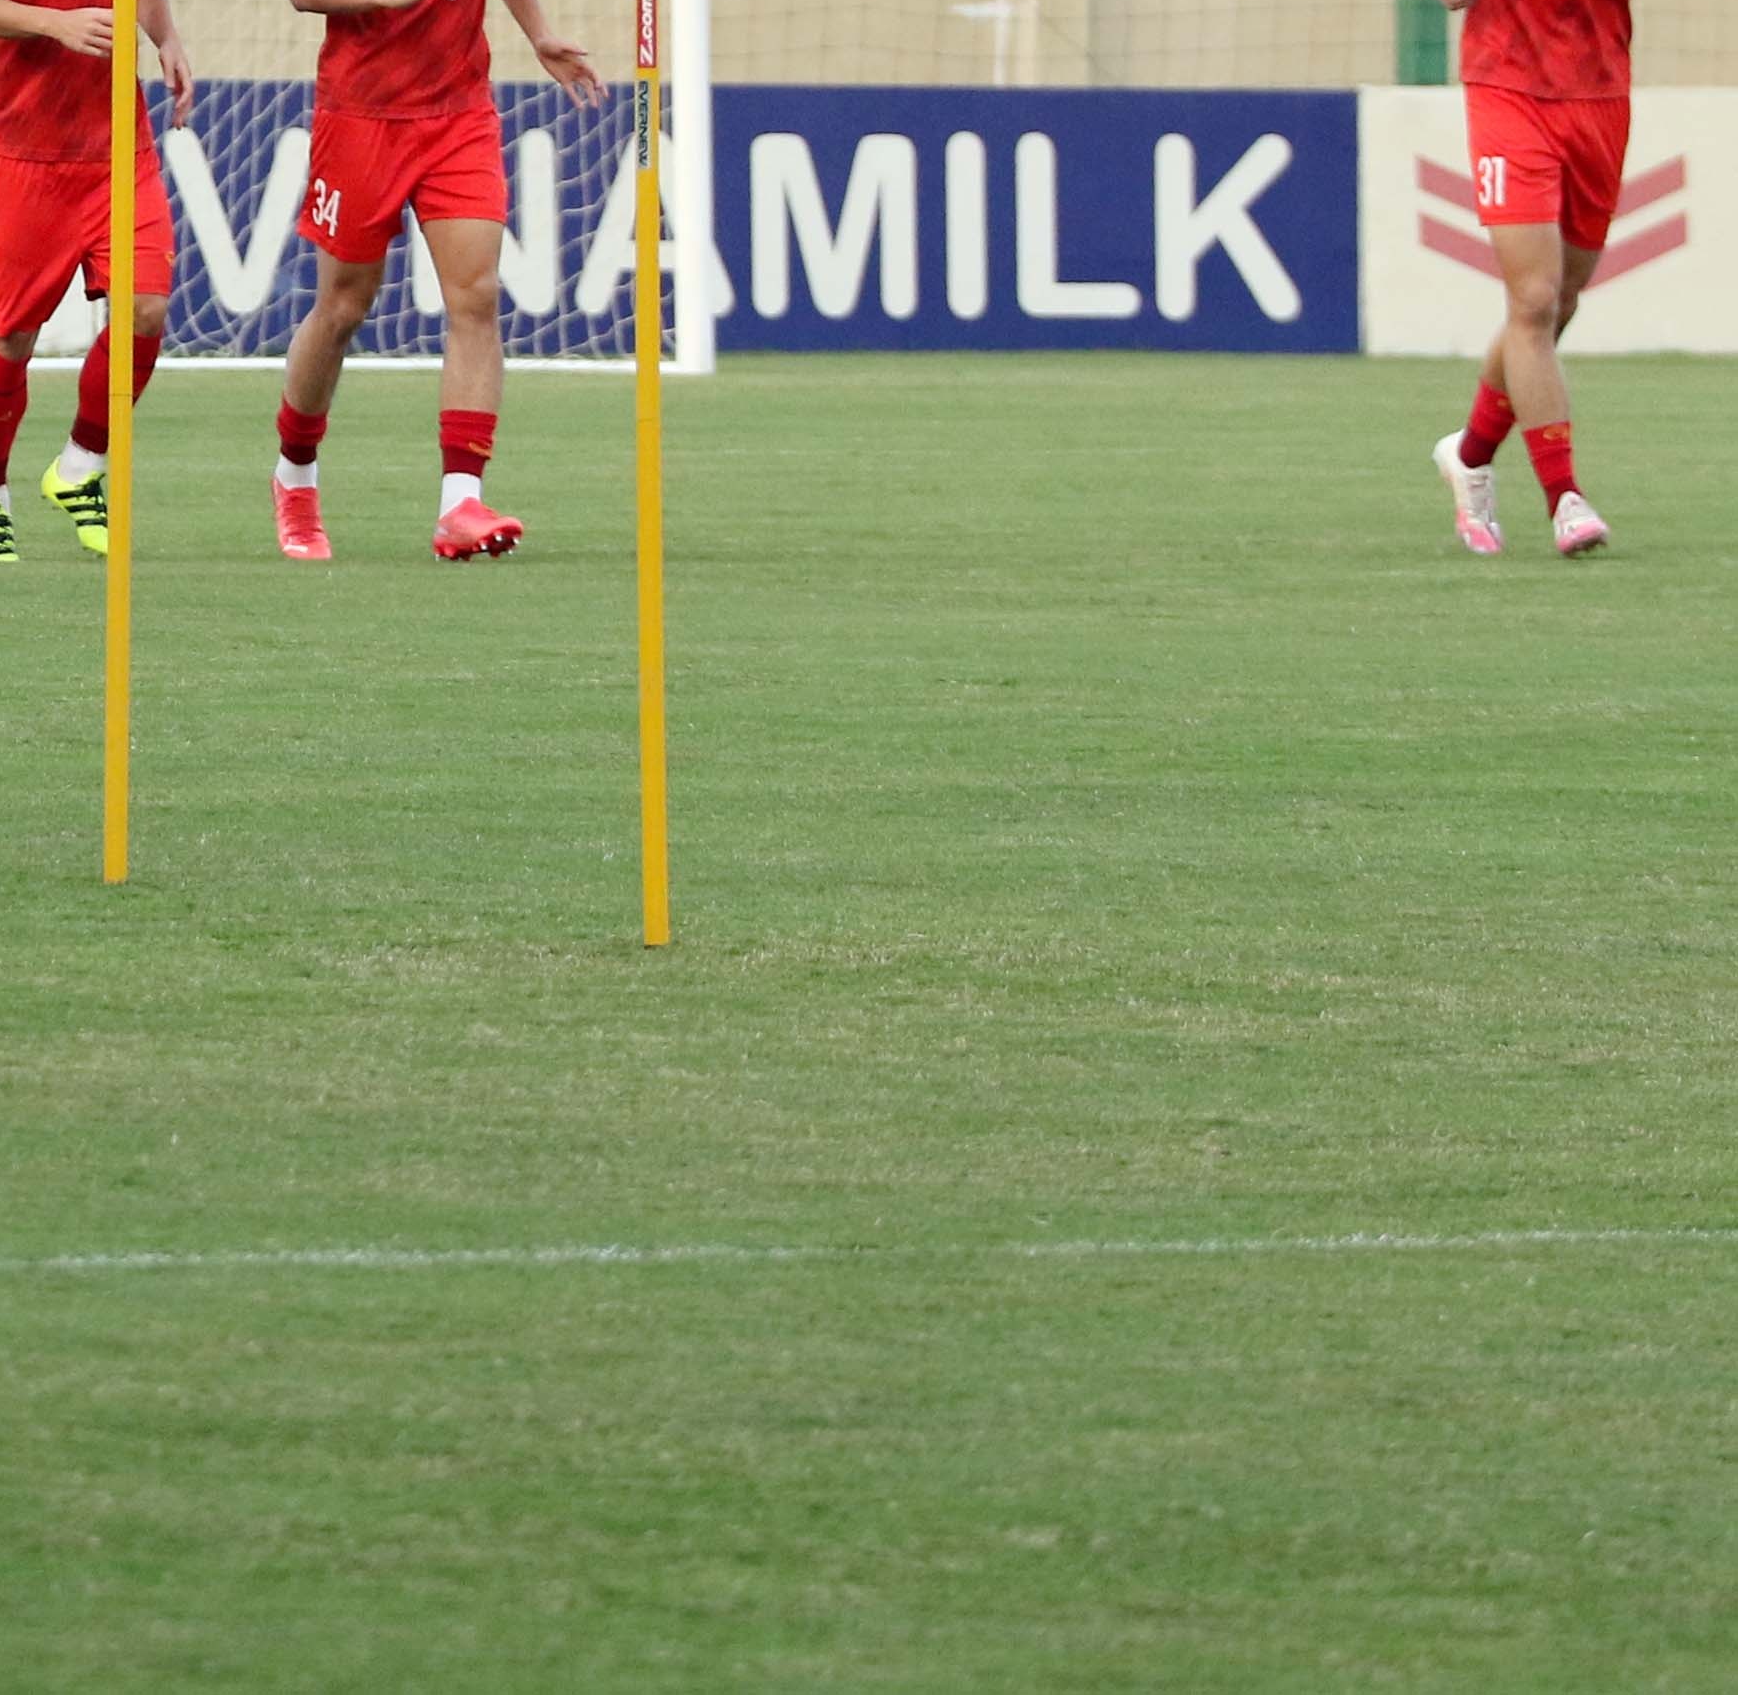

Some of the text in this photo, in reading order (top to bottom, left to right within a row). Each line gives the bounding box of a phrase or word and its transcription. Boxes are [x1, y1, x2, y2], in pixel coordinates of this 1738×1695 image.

[637, 80, 649, 168] EVERNEW
[312, 177, 342, 237] 34
[1477, 155, 1507, 206] 31
[163, 127, 1303, 323] VNAMILK
